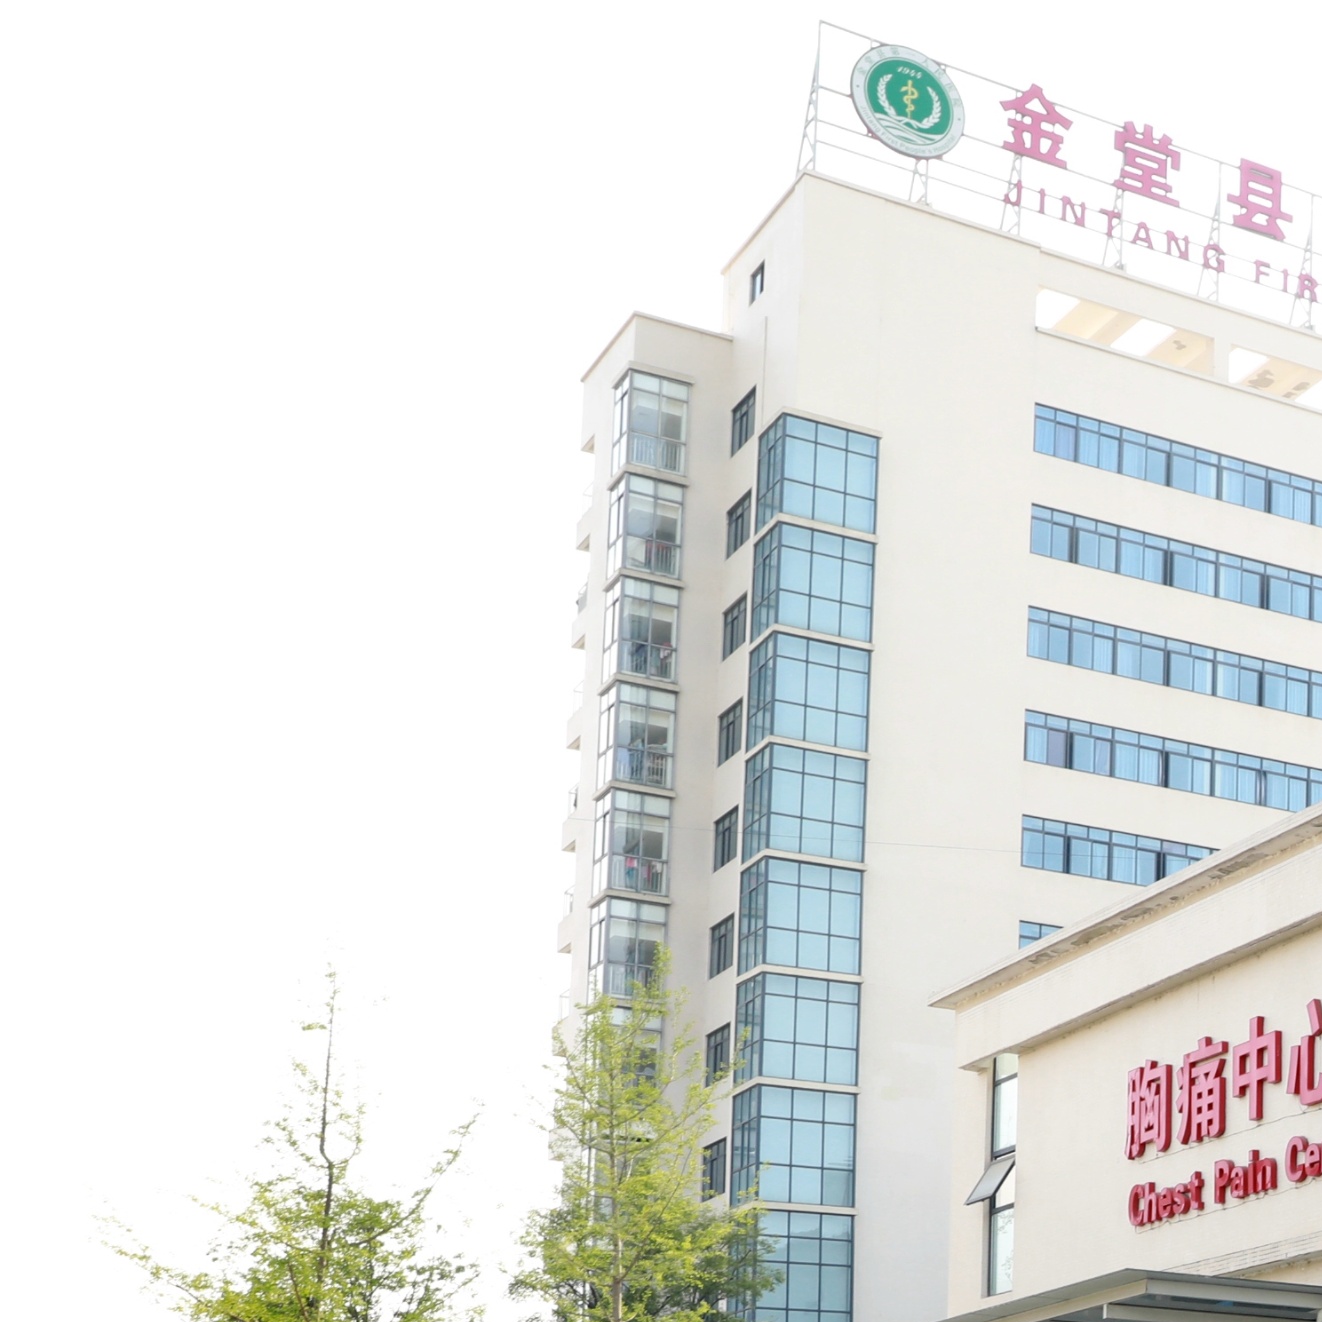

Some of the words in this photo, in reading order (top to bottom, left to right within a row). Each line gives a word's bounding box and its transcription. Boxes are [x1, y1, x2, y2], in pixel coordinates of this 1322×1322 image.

[1002, 181, 1225, 273] JINTANG
[1128, 1171, 1204, 1228] Chest
[1214, 1149, 1277, 1205] Pain
